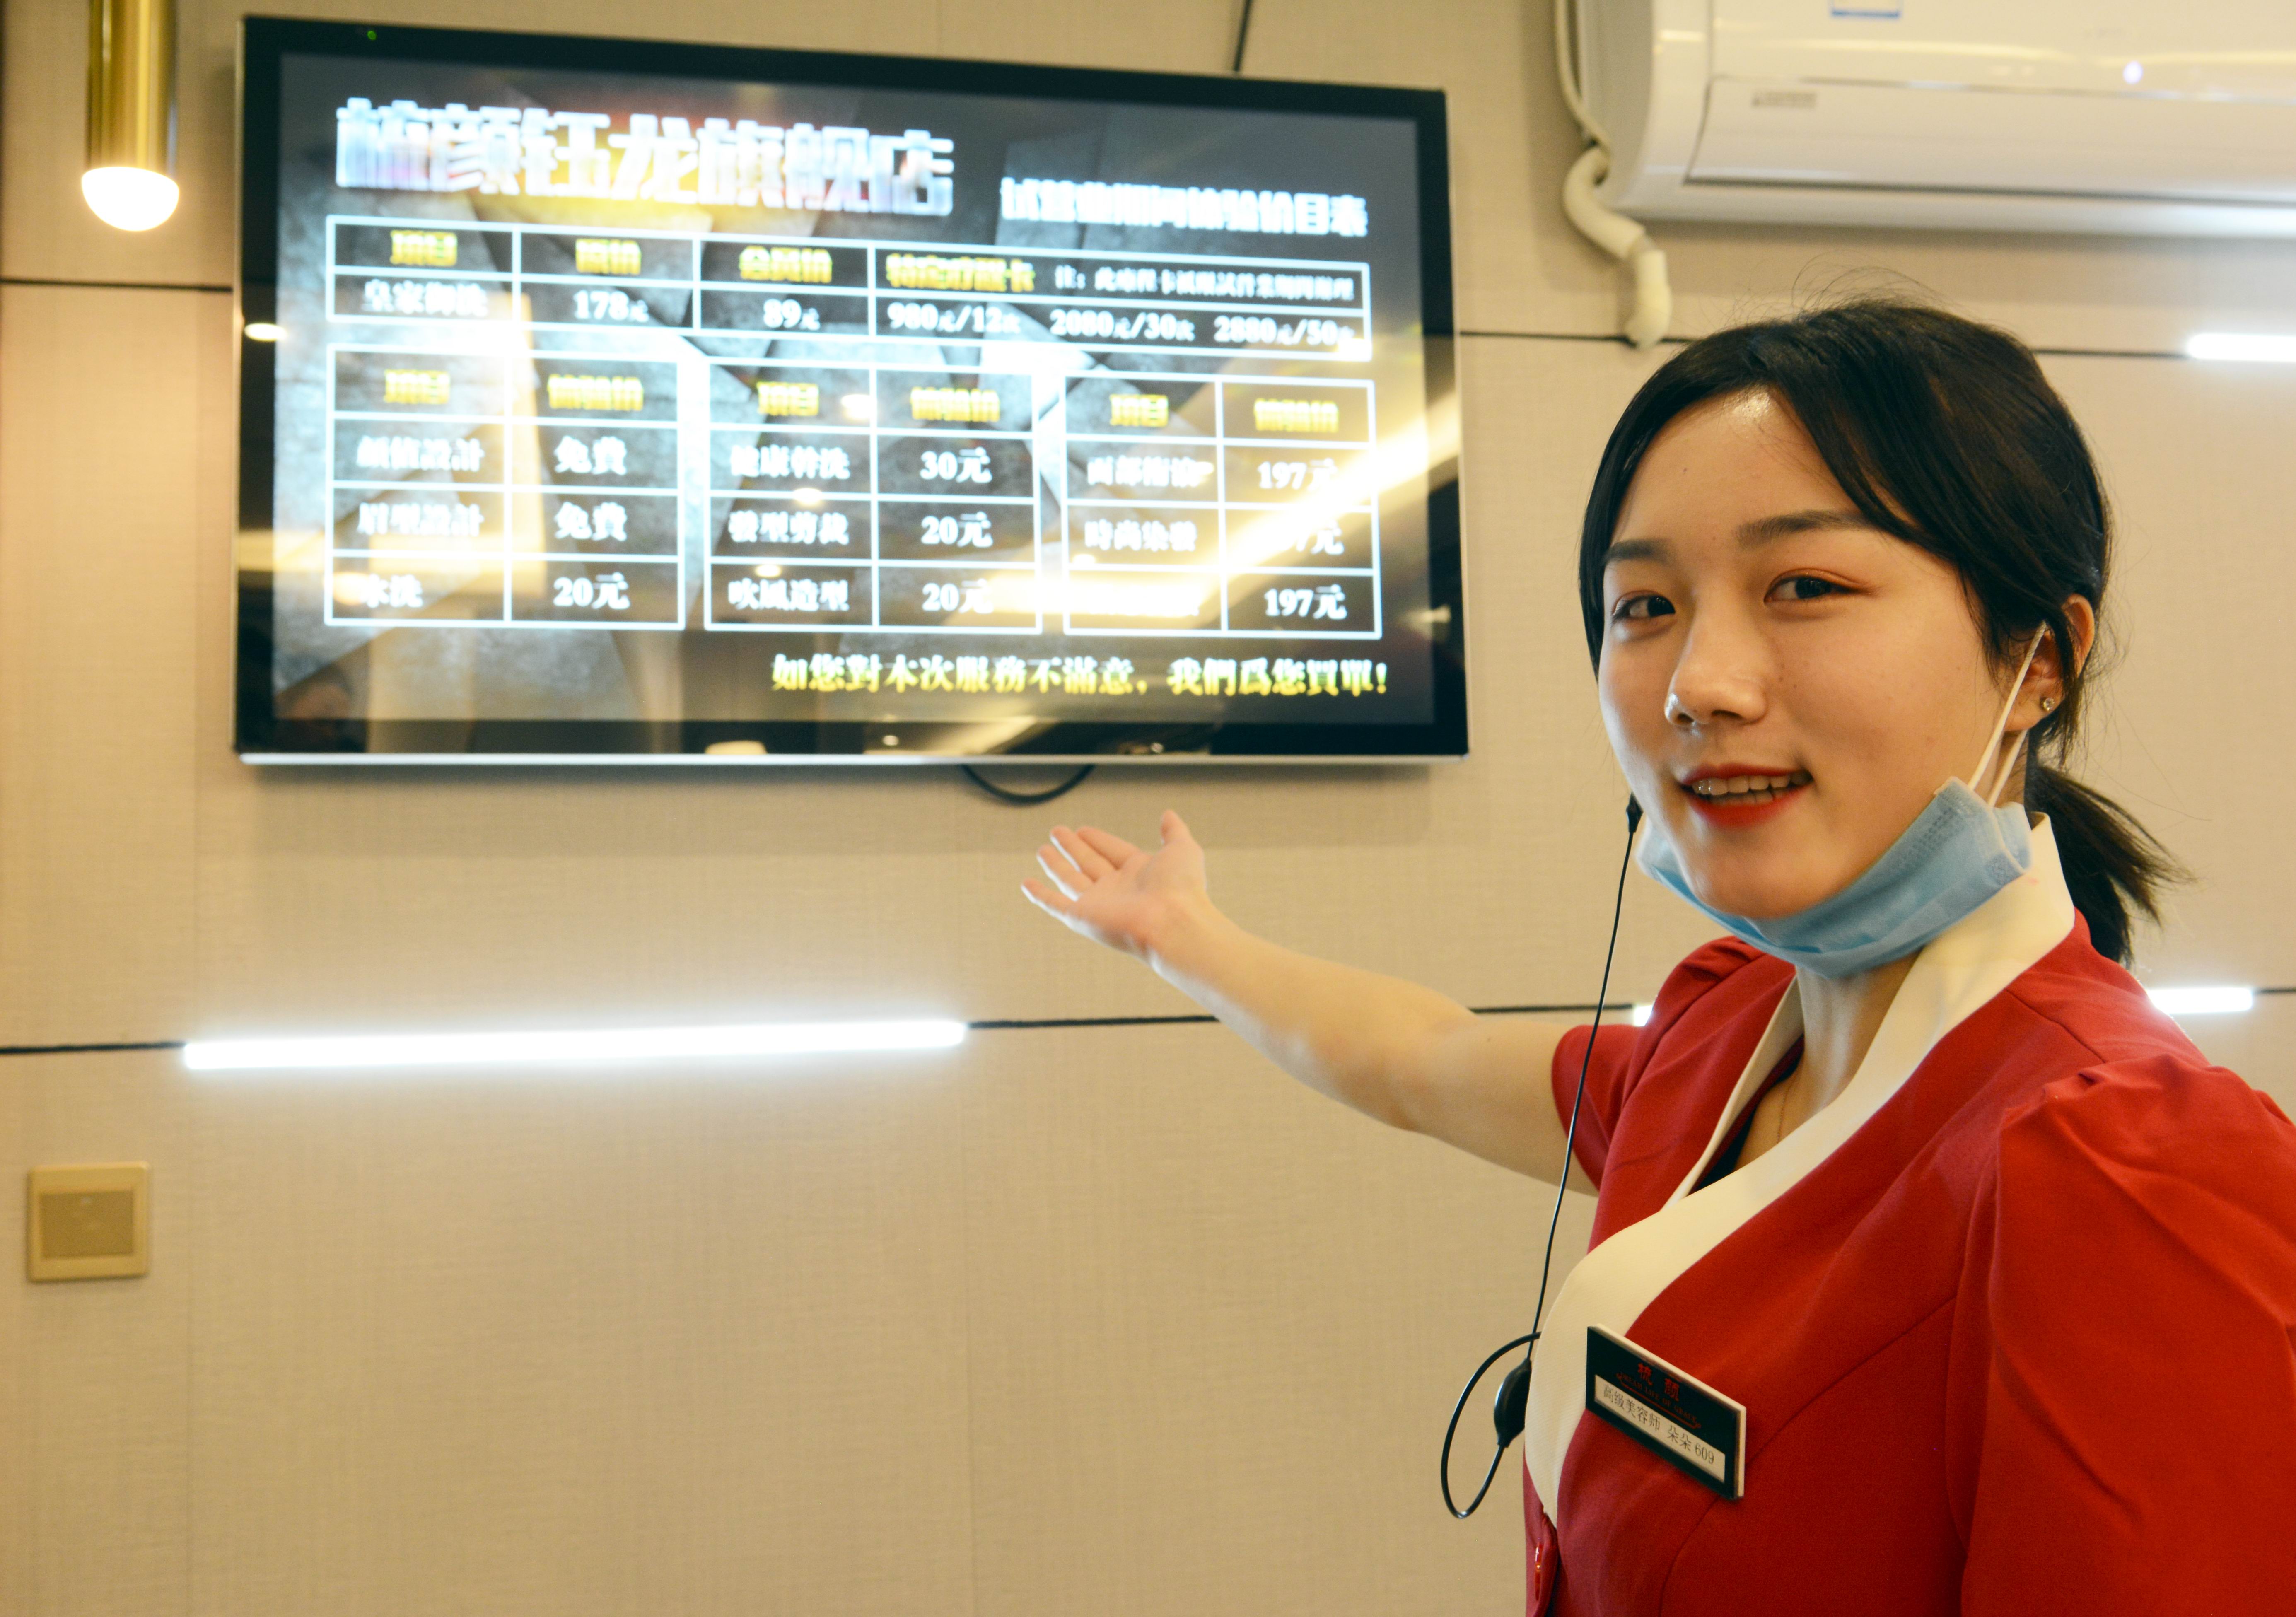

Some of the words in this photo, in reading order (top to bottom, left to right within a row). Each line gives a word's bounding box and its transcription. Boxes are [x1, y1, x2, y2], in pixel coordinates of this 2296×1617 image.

[555, 435, 628, 475] 免費
[920, 447, 992, 484] 30元
[1257, 458, 1339, 492] 197元
[555, 501, 628, 542] 免費
[921, 512, 993, 548] 20元
[553, 572, 630, 610] 20元
[728, 578, 850, 611] 吹風造型
[922, 578, 994, 614] 20元
[1265, 585, 1347, 620] 197元
[1603, 1383, 1661, 1432] 高级美容师
[1666, 1424, 1692, 1452] 朵朵
[1695, 1442, 1715, 1465] 609
